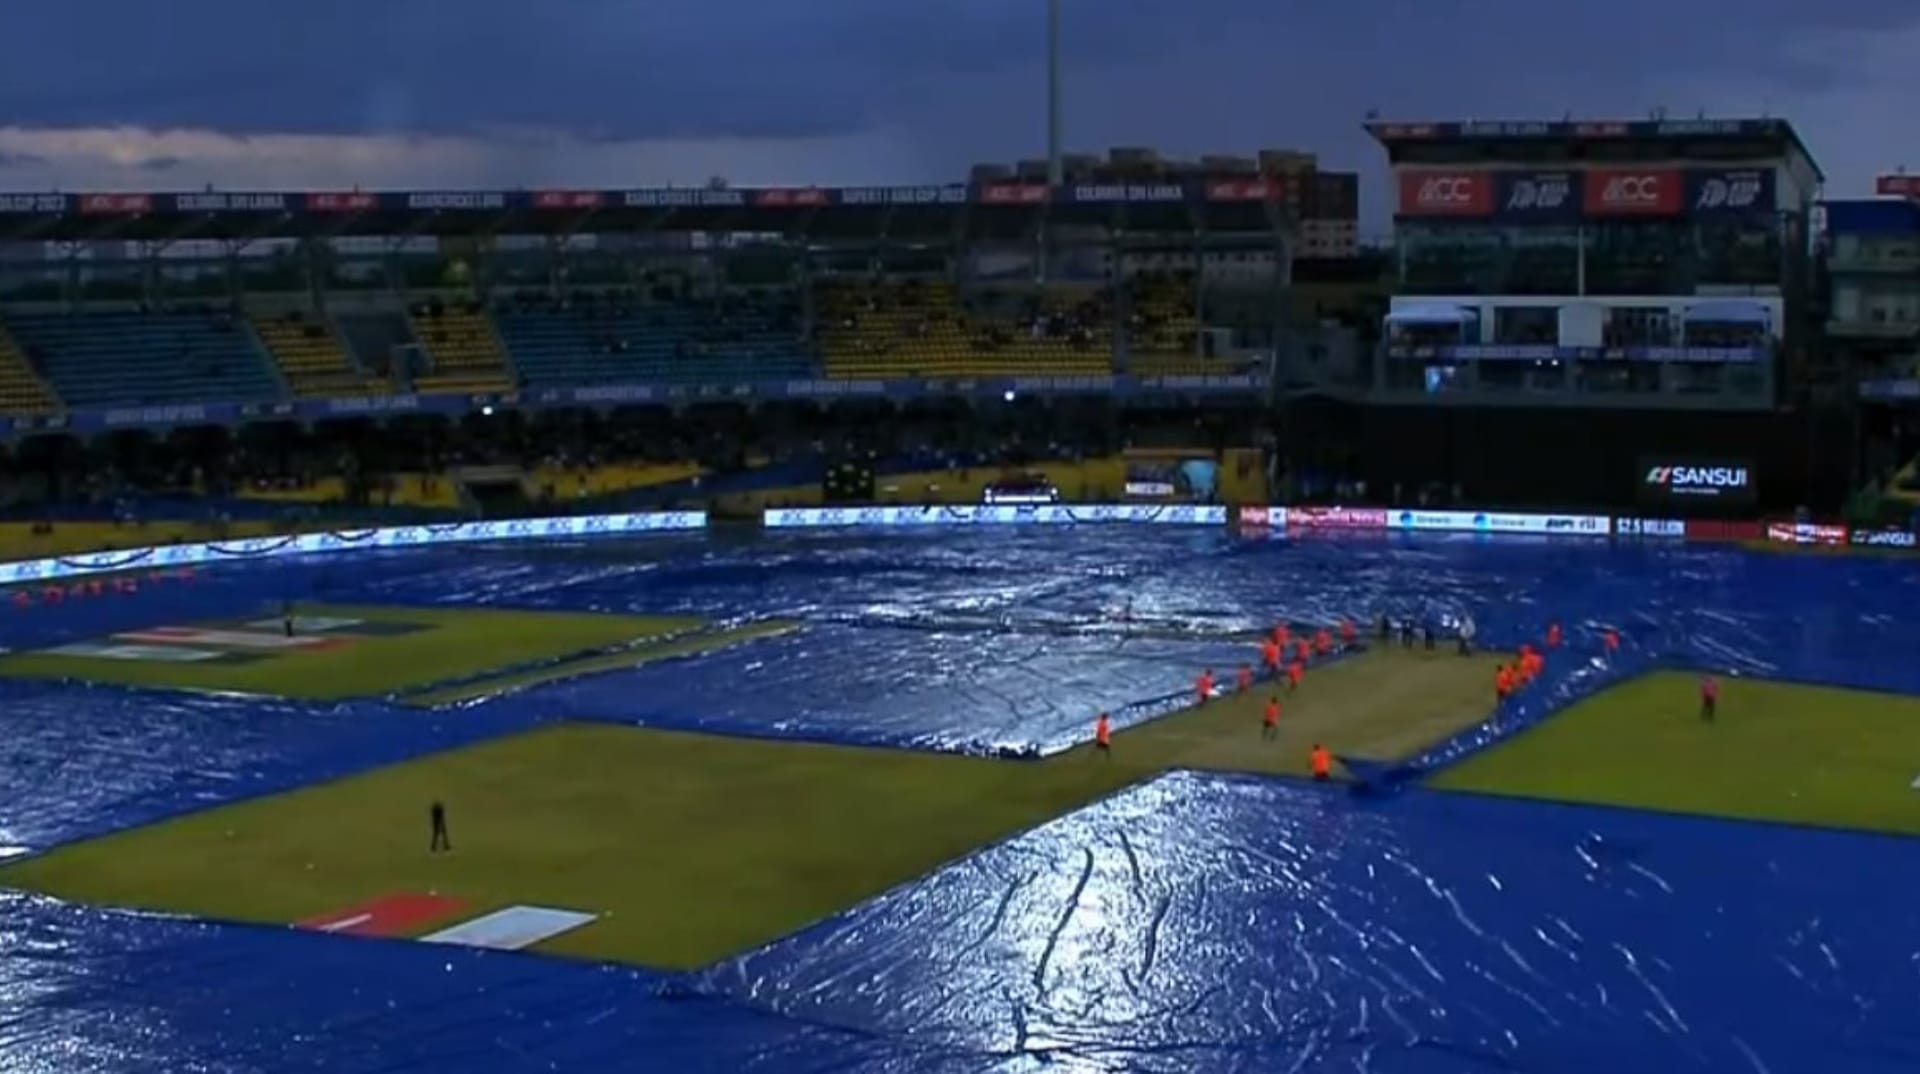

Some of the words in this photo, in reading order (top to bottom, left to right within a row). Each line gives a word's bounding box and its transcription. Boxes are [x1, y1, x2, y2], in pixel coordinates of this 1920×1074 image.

[1417, 177, 1472, 201] ACC
[1601, 176, 1657, 201] ACC
[1671, 467, 1746, 486] SANSUI
